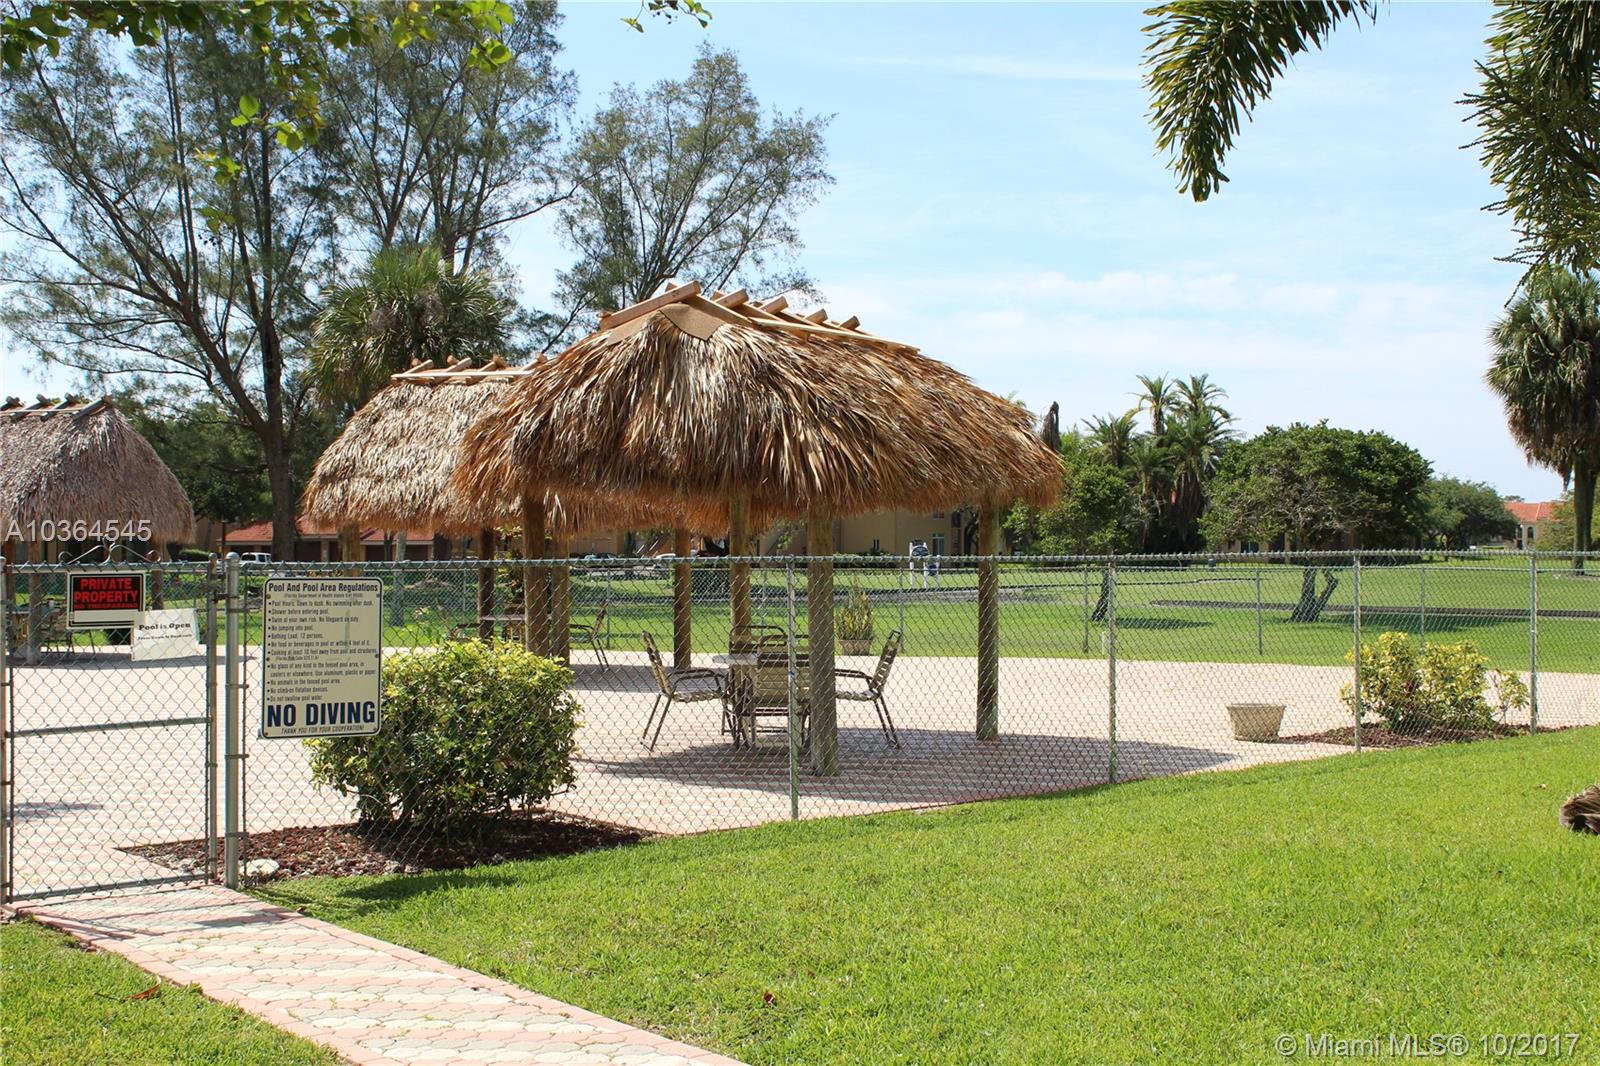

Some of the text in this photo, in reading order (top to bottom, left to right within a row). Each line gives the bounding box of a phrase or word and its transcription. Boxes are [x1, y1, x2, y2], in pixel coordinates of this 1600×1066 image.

[81, 578, 132, 590] PRIVATE
[269, 583, 378, 592] Pool And Pool Area Regulations
[74, 591, 138, 602] PROPERTY
[267, 701, 375, 727] NO DIVING
